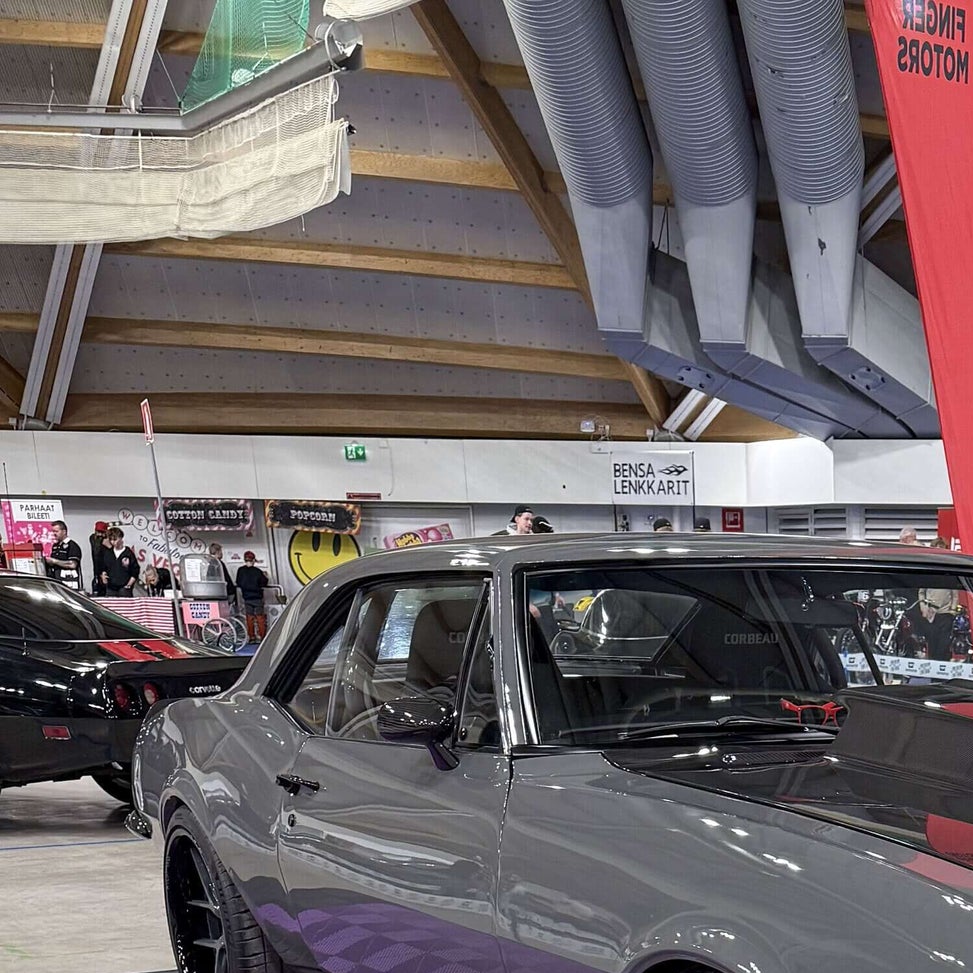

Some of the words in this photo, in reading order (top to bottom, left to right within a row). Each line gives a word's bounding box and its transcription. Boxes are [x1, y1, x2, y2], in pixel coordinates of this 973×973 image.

[613, 463, 655, 478] BENSA
[614, 480, 689, 495] LENKKARIT
[166, 510, 205, 520] COTTON
[208, 509, 243, 520] CANDY
[289, 510, 336, 522] POPCORN
[725, 633, 779, 644] CORBEAU
